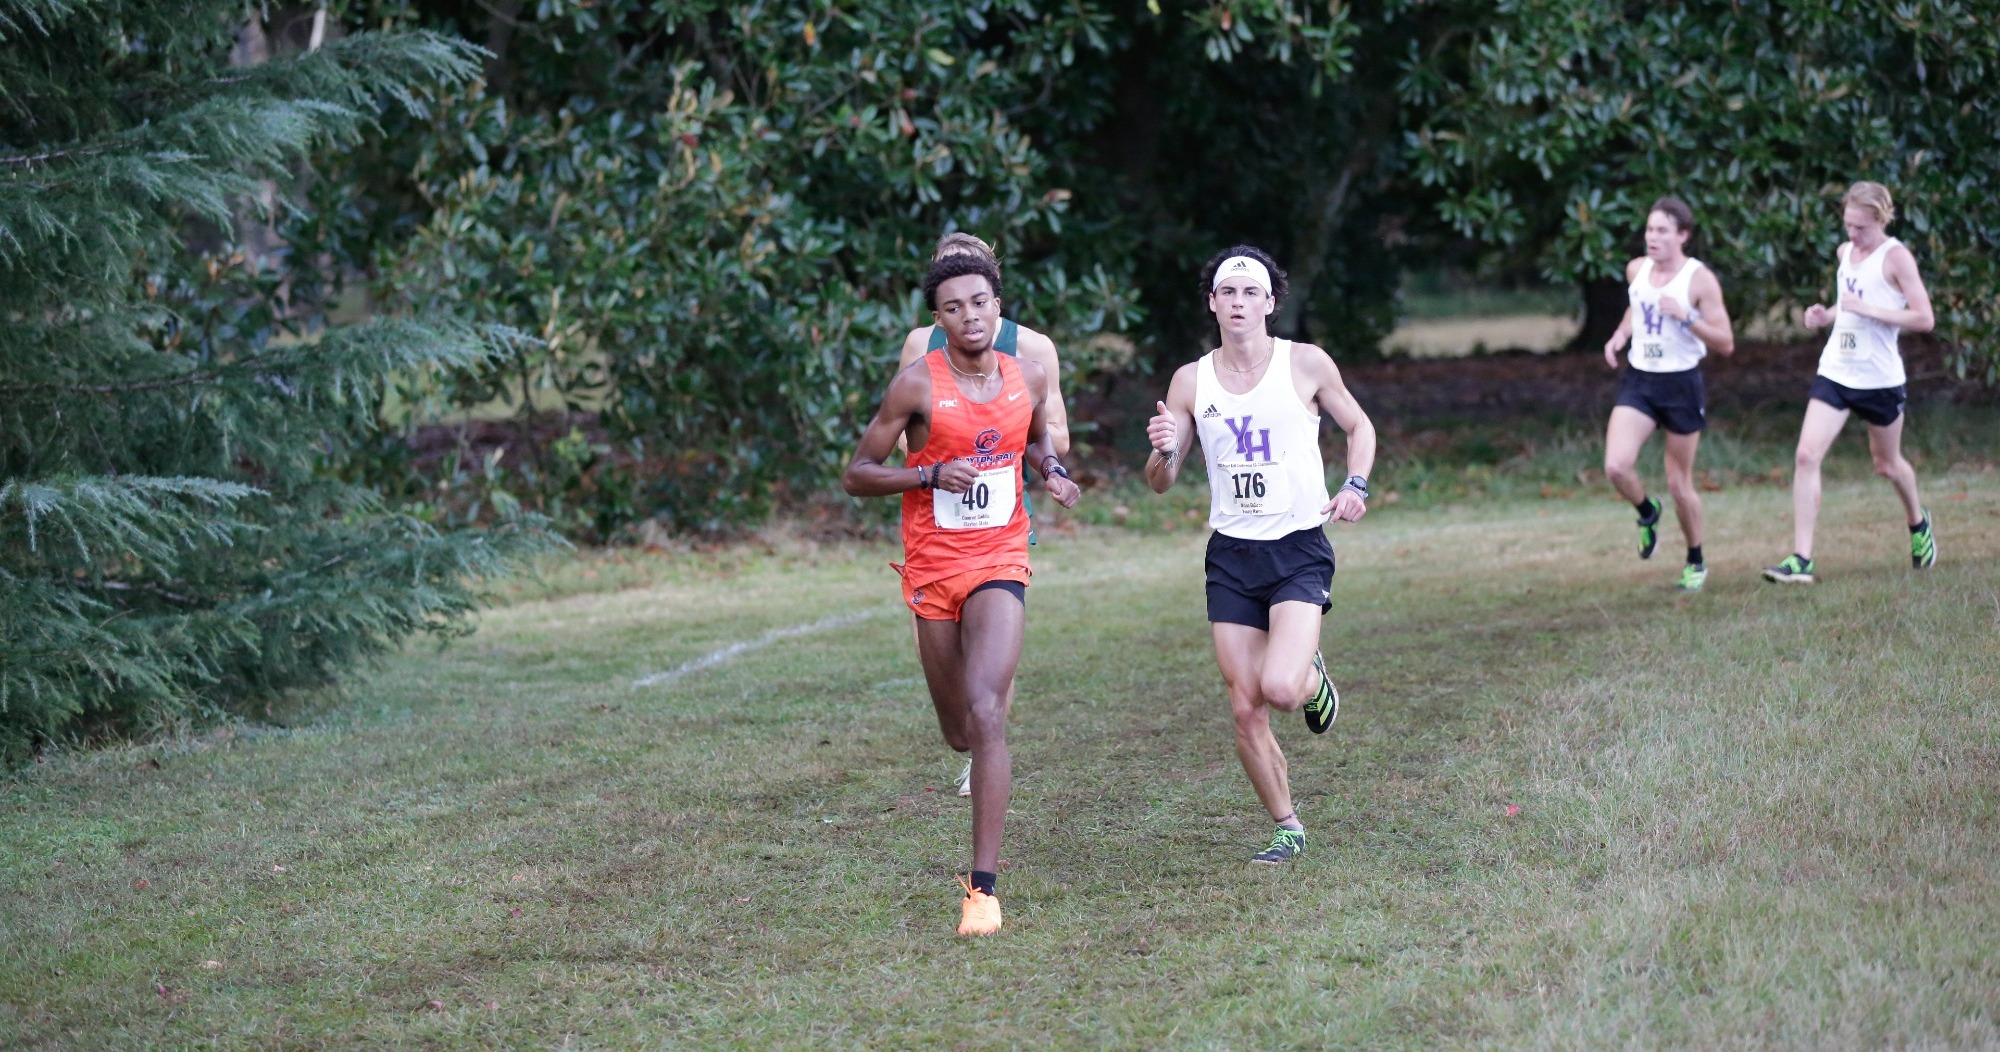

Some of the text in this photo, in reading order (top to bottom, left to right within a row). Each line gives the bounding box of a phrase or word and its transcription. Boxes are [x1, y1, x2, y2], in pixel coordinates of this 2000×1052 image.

[1224, 414, 1271, 461] YH
[962, 483, 989, 510] 40
[1232, 472, 1266, 498] 176
